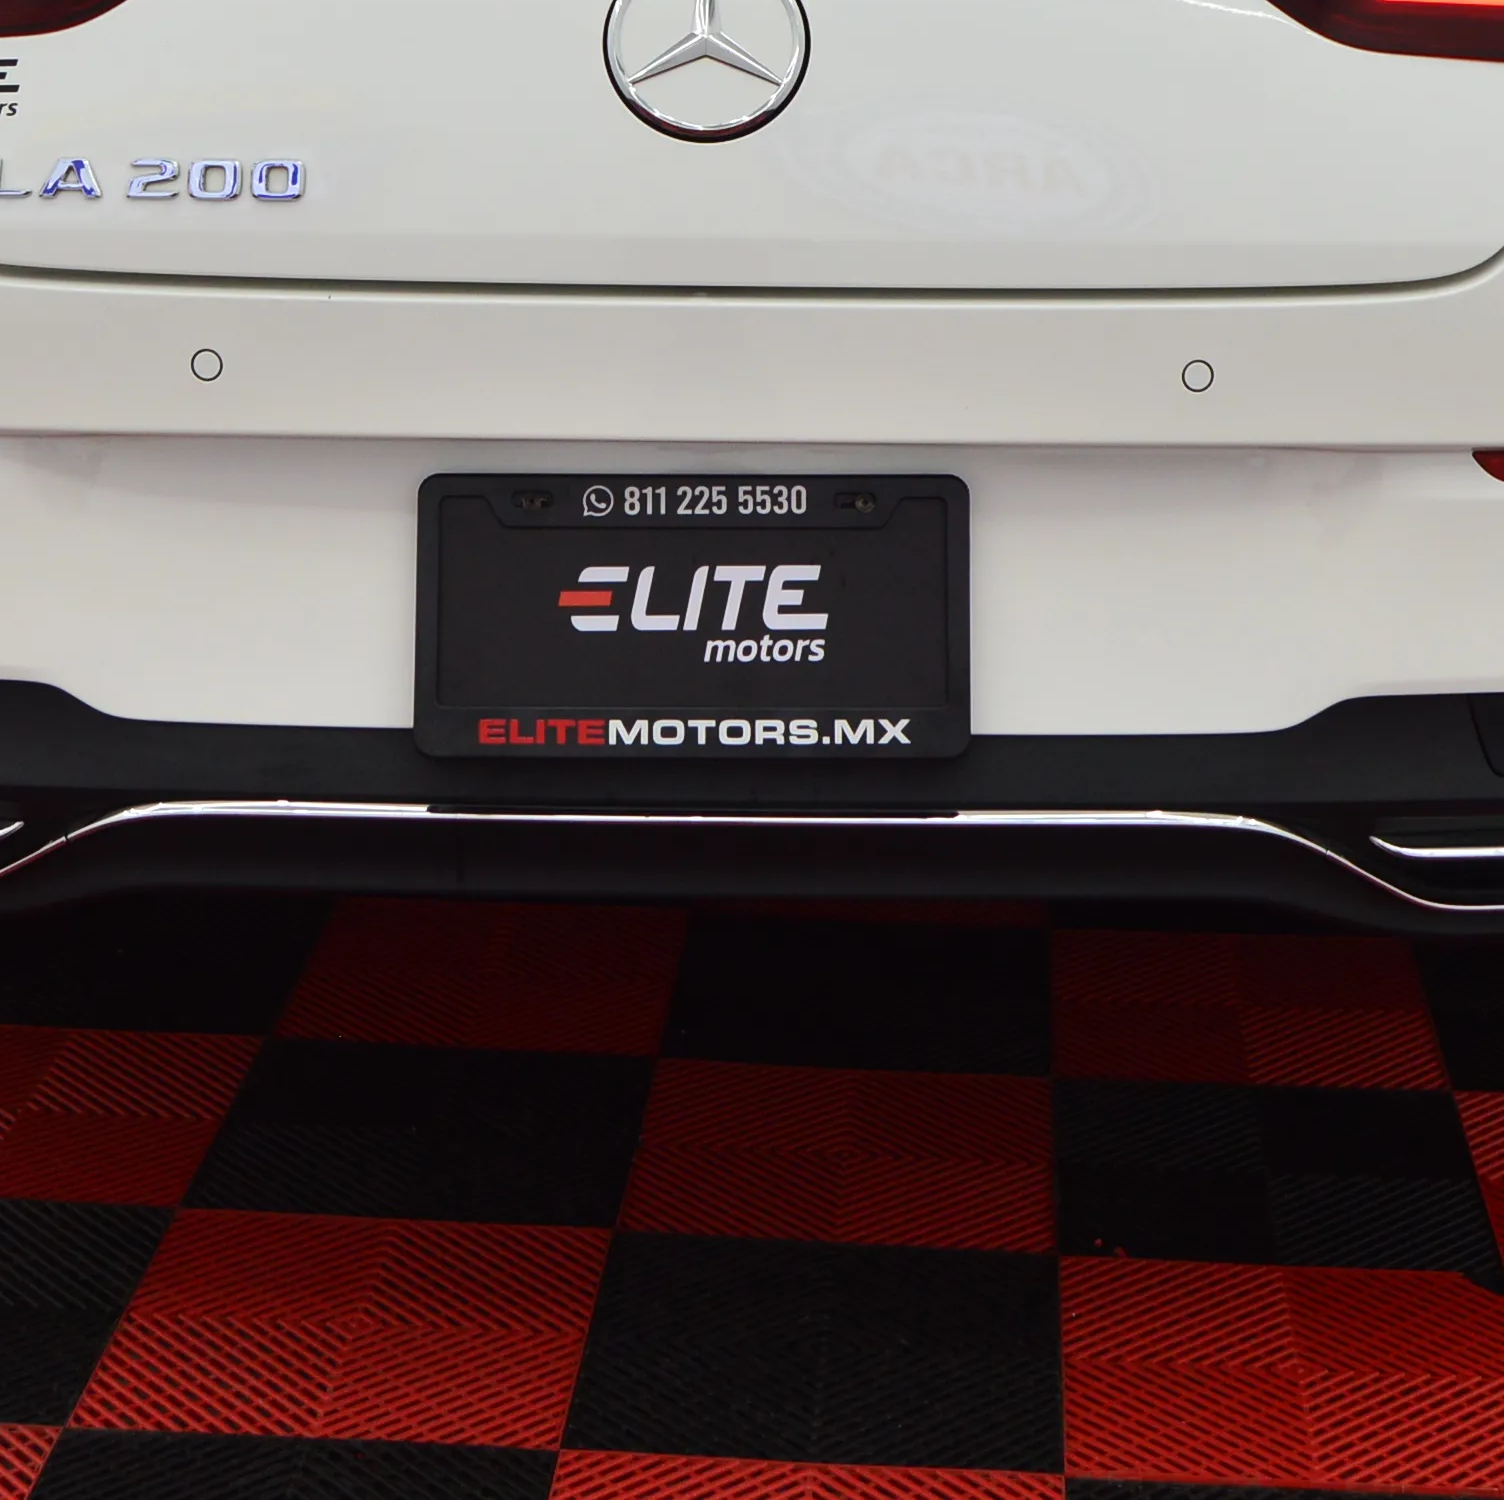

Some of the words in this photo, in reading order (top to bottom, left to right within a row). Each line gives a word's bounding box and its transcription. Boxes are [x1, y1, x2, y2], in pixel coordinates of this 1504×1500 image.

[126, 157, 307, 201] 200
[623, 486, 668, 516] 811
[676, 485, 728, 515] 225
[738, 485, 808, 515] 5530
[558, 564, 829, 632] ELITE
[704, 634, 826, 663] motors
[477, 717, 912, 746] ELITEMOTORS.MX
